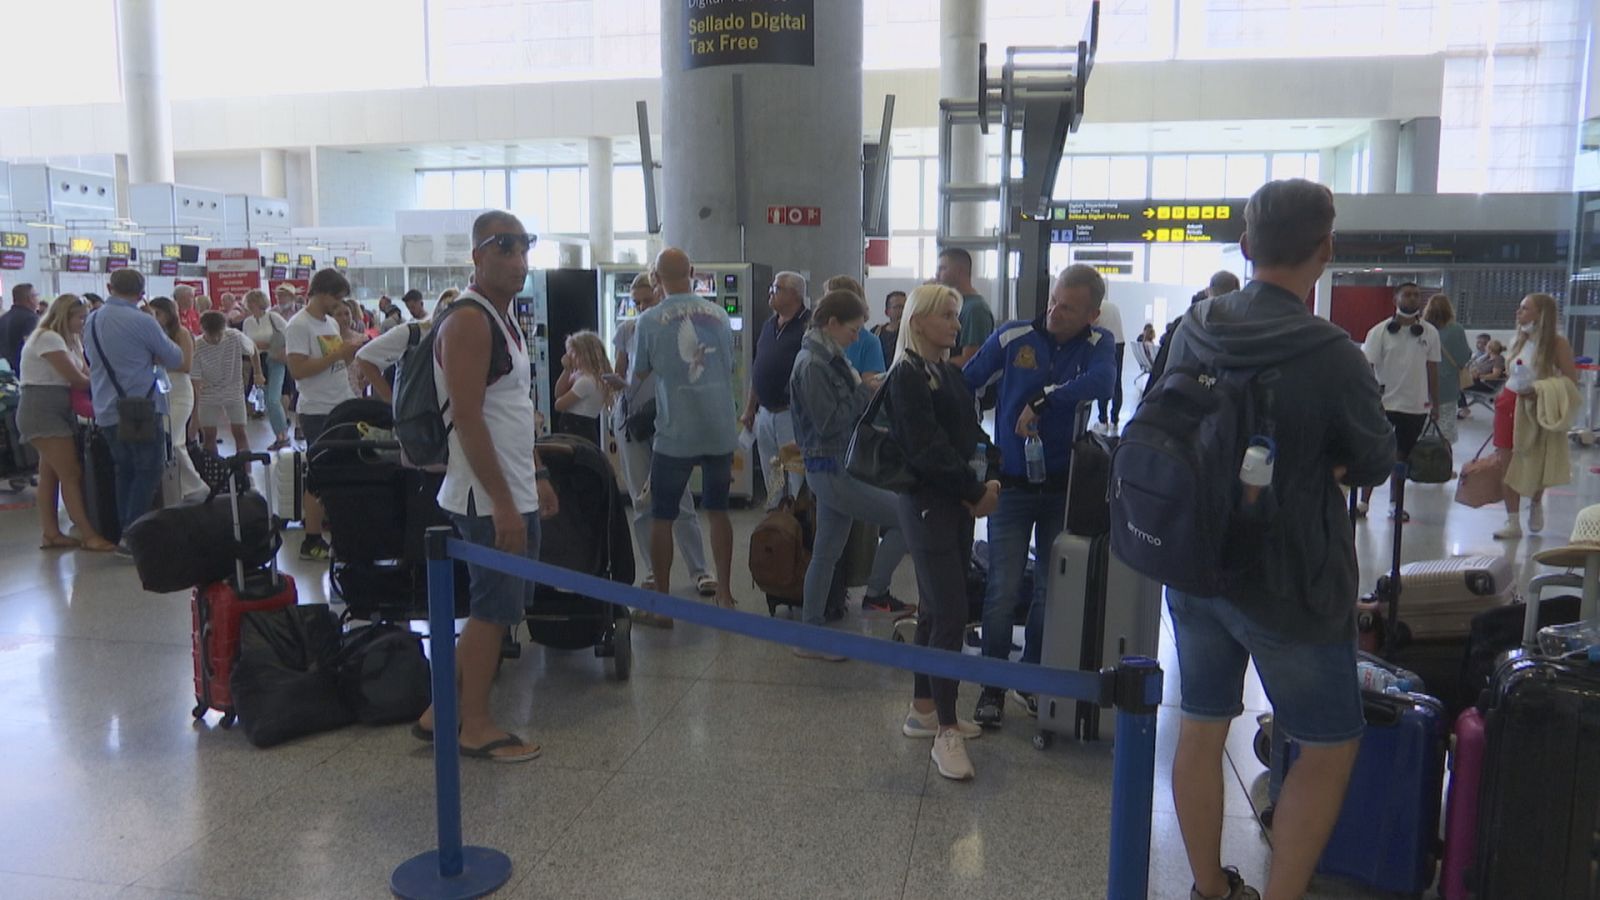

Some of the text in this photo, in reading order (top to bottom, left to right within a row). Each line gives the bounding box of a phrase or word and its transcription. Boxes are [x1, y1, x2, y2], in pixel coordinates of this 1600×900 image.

[688, 11, 806, 35] Sellado Digital
[688, 34, 759, 55] Tax Free
[5, 234, 27, 247] 379
[111, 241, 129, 254] 381
[164, 245, 181, 258] 382
